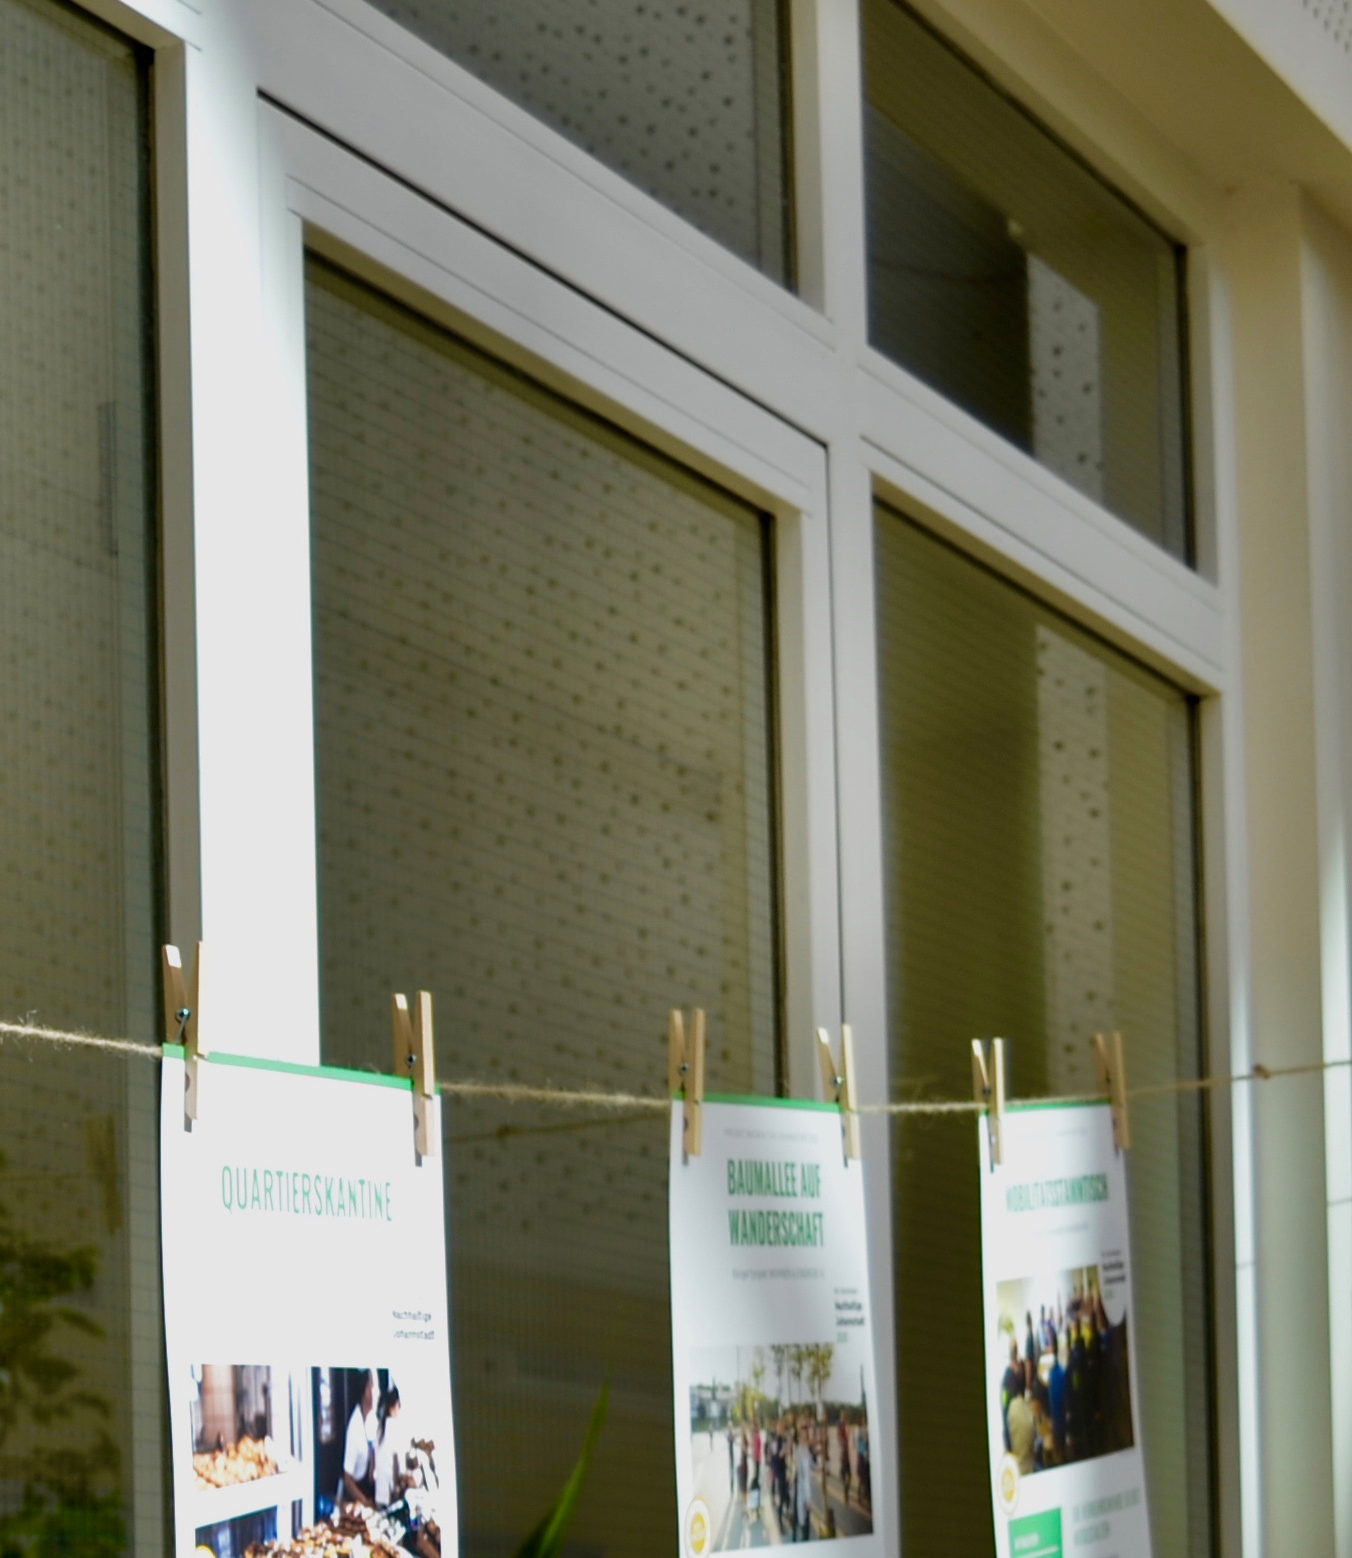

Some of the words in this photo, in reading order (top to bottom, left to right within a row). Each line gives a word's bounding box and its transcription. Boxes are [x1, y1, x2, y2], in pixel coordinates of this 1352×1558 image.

[222, 1166, 392, 1221] QUARTIERSKANTINE
[727, 1159, 797, 1196] BAUMALLEE
[801, 1163, 820, 1197] AUF
[728, 1210, 824, 1247] WANDERSCHAFT
